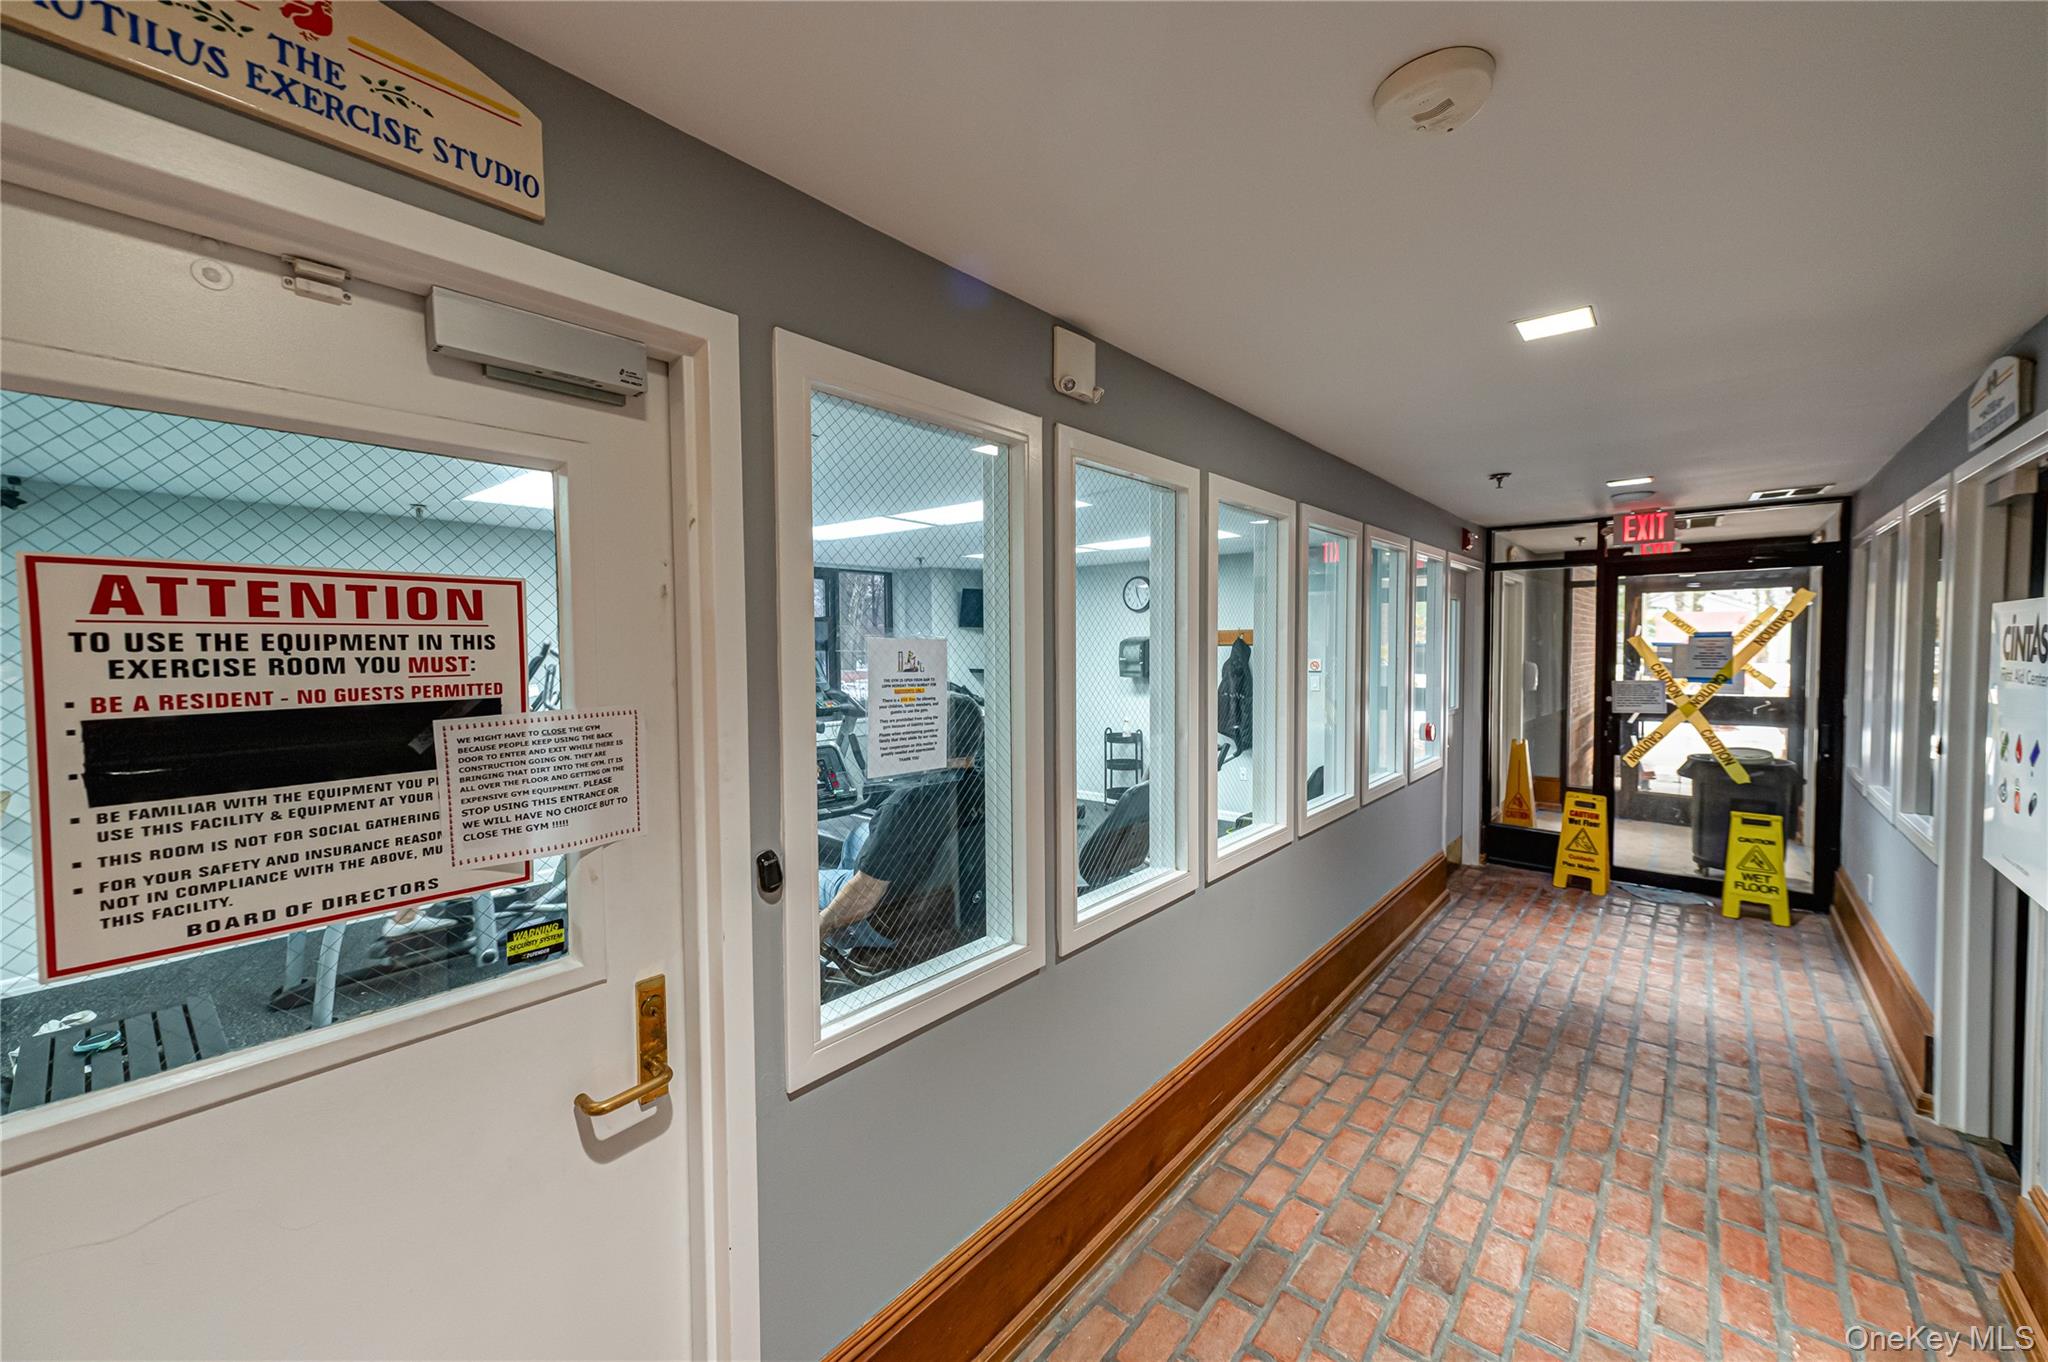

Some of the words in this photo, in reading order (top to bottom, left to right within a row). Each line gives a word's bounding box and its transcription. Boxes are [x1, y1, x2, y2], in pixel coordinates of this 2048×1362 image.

[268, 33, 346, 90] THE
[246, 60, 423, 153] EXERCISE
[433, 136, 540, 198] STUDIO
[1623, 511, 1669, 542] EXIT
[89, 575, 483, 619] ATTENTION
[67, 632, 110, 652] TO
[124, 632, 183, 651] USE
[195, 633, 248, 651] THE
[261, 633, 409, 654] EQUIPMENT
[418, 634, 442, 650] IN
[449, 634, 495, 649] THIS
[1754, 609, 1794, 647] CAUTION
[108, 658, 256, 678] EXERCISE
[268, 657, 345, 675] ROOM
[354, 656, 400, 673] YOU
[408, 656, 475, 674] MUST:
[1650, 662, 1683, 699] CAUTION
[90, 696, 122, 712] BE
[133, 695, 149, 711] A
[159, 691, 273, 709] RESIDENT
[297, 689, 326, 703] NO
[334, 686, 404, 702] GUESTS
[411, 682, 502, 698] PERMITTED
[1690, 674, 1728, 707] CAUTION
[457, 744, 495, 753] BECAUSE
[498, 740, 529, 748] PEOPLE
[554, 735, 579, 743] USING
[458, 755, 483, 763] DOOR
[499, 750, 526, 758] ENTER
[1627, 731, 1663, 763] CAUTION
[1700, 729, 1736, 766] CAUTION
[458, 760, 526, 773] CONSTRUCTION
[528, 756, 556, 764] GOING
[459, 771, 504, 782] BRINGING
[506, 768, 527, 776] THAT
[521, 776, 548, 784] FLOOR
[569, 769, 600, 778] GETTING
[96, 811, 120, 824] BE
[128, 801, 216, 820] FAMILIAR
[223, 795, 267, 809] WITH
[272, 791, 301, 803] THE
[307, 782, 392, 800] EQUIPMENT
[397, 778, 422, 789] YOU
[460, 792, 508, 804] EXPENSIVE
[583, 776, 614, 787] PLEASE
[460, 806, 490, 817] STOP
[493, 800, 528, 811] USING
[531, 797, 557, 806] THIS
[560, 789, 605, 802] ENTRANCE
[607, 786, 620, 794] OR
[96, 827, 133, 842] USE
[140, 821, 183, 836] THIS
[190, 812, 263, 830] FACILITY
[270, 810, 282, 820] &
[288, 799, 375, 818] EQUIPMENT
[379, 796, 394, 806] AT
[399, 792, 433, 803] YOUR
[462, 819, 479, 828] WE
[483, 815, 511, 825] WILL
[515, 811, 542, 820] HAVE
[546, 808, 561, 816] NO
[564, 802, 597, 813] CHOICE
[599, 798, 614, 807] BUT
[1568, 818, 1581, 826] Wet
[1583, 820, 1600, 828] Floor
[1569, 810, 1600, 820] CAUTION
[96, 851, 141, 867] THIS
[149, 843, 203, 860] ROOM
[211, 840, 227, 851] IS
[234, 834, 267, 848] NOT
[274, 830, 302, 842] FOR
[308, 822, 360, 837] SOCIAL
[462, 829, 497, 841] CLOSE
[500, 825, 522, 835] THE
[525, 822, 548, 831] GYM
[1737, 836, 1776, 846] CAUTION
[98, 877, 135, 892] FOR
[142, 869, 191, 885] YOUR
[198, 858, 260, 877] SAFETY
[265, 852, 299, 866] AND
[305, 839, 389, 859] INSURANCE
[99, 894, 139, 910] NOT
[147, 890, 168, 903] IN
[175, 870, 287, 897] COMPLIANCE
[293, 863, 333, 877] WITH
[338, 857, 364, 870] THE
[370, 849, 417, 865] ABOVE,
[1741, 872, 1771, 884] WET
[1734, 880, 1780, 895] FLOOR
[99, 912, 144, 928] THIS
[152, 896, 233, 919] FACILITY.
[186, 909, 275, 936] BOARD
[285, 901, 312, 917] OF
[321, 878, 438, 909] DIRECTORS
[509, 939, 538, 952] SECURITY
[540, 932, 563, 944] SYSTEM
[513, 922, 559, 942] WARNING
